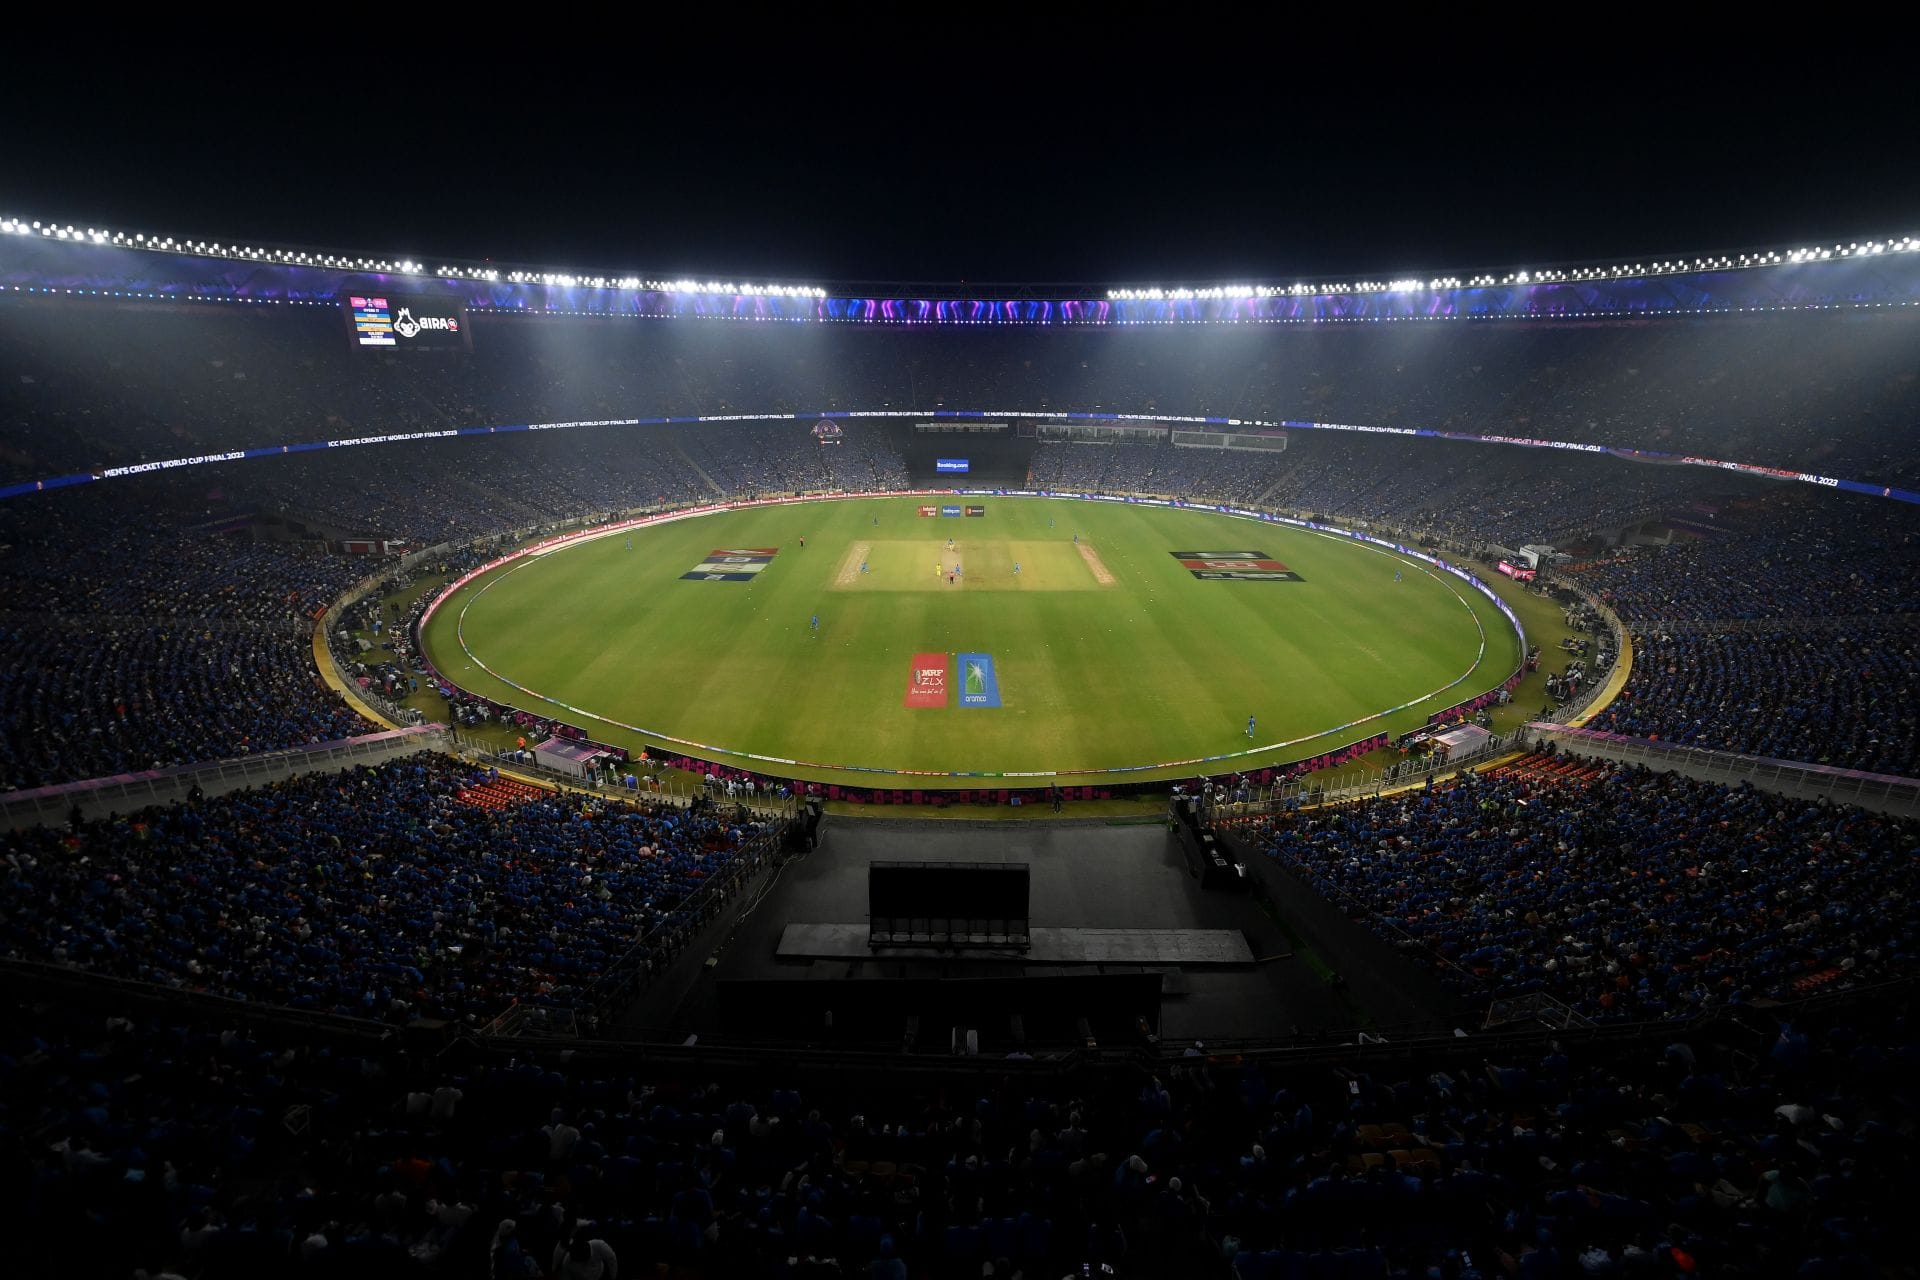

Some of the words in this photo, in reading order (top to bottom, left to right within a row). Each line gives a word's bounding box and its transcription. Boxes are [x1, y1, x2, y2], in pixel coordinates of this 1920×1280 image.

[420, 317, 449, 330] BIRA
[361, 436, 386, 444] CRICKET
[104, 467, 129, 478] MEN'S
[129, 462, 161, 474] CRICKET
[161, 459, 187, 469] WORLD
[188, 457, 204, 465] CUP
[205, 454, 227, 463] FINAL
[227, 452, 245, 460] 2023
[1794, 472, 1818, 483] FINAL
[1818, 476, 1838, 487] 2023
[921, 669, 944, 677] MRF
[921, 677, 944, 686] ZLX
